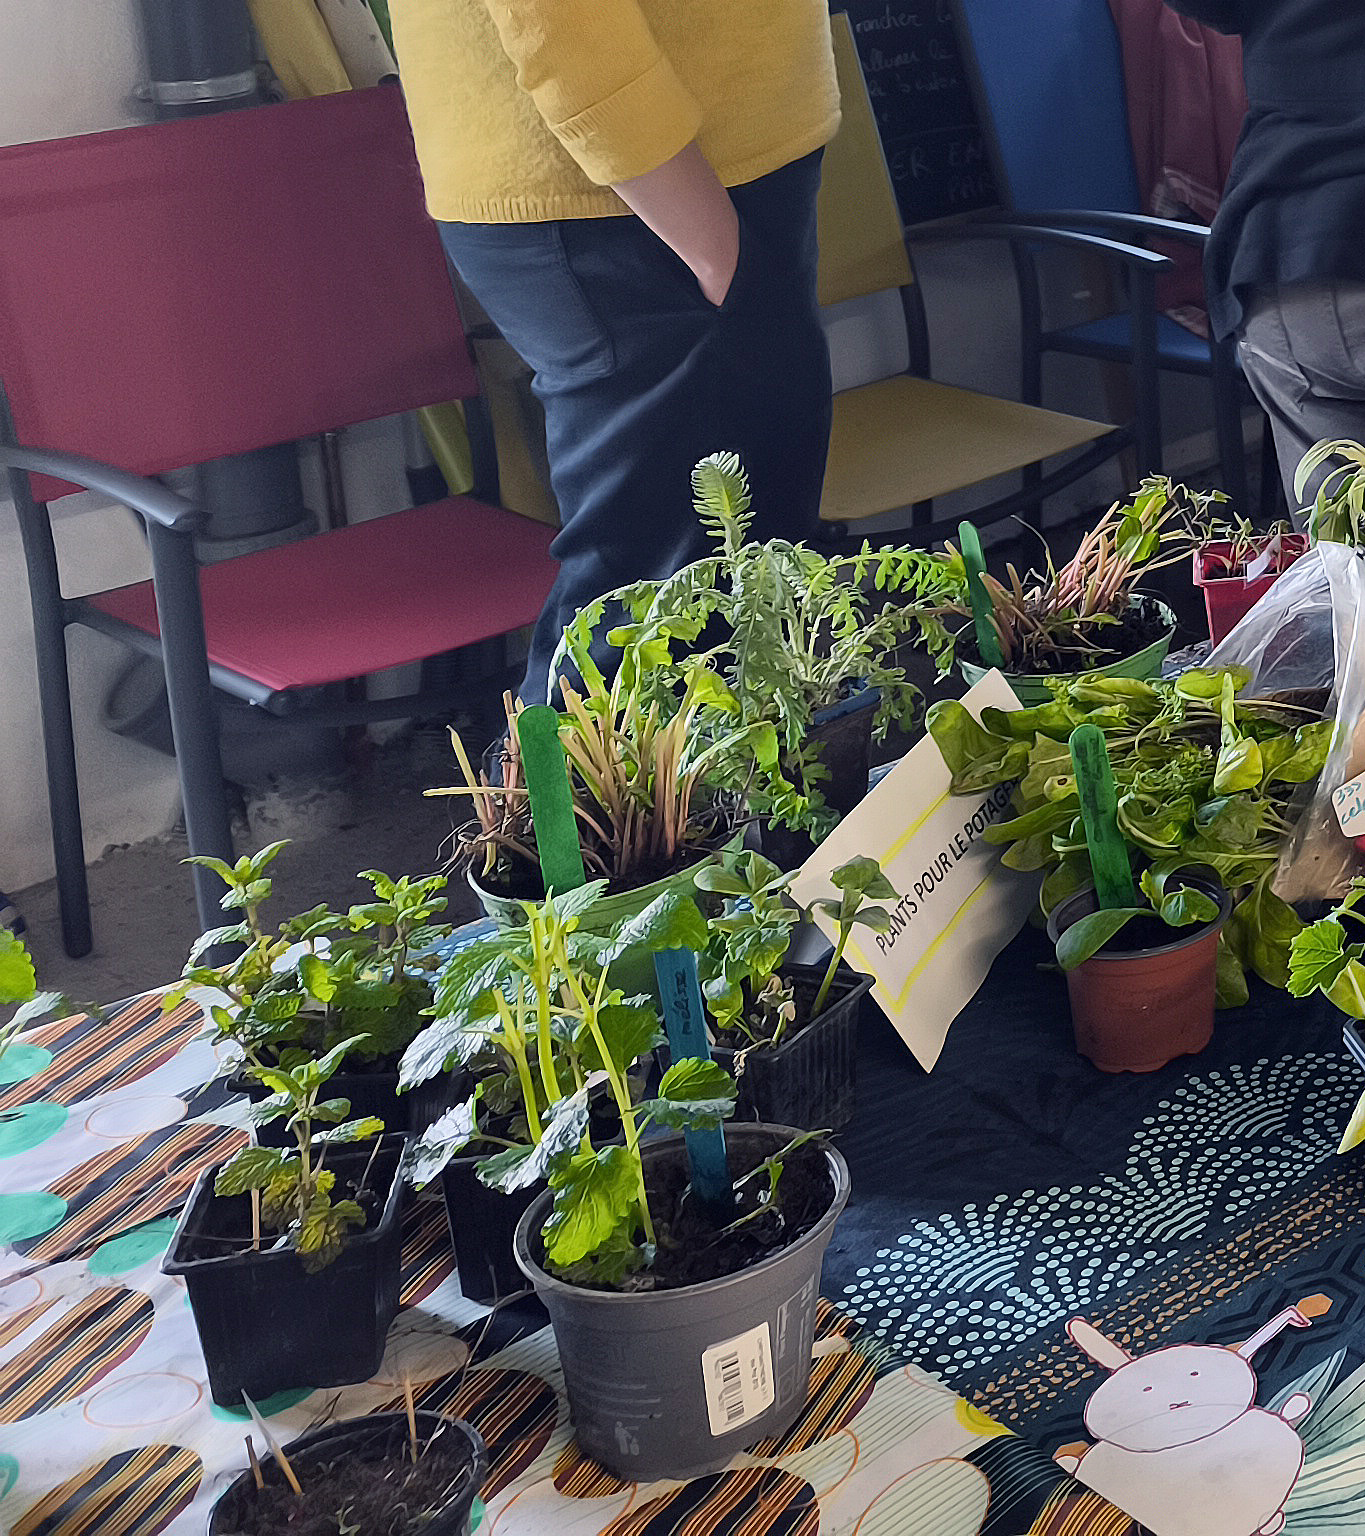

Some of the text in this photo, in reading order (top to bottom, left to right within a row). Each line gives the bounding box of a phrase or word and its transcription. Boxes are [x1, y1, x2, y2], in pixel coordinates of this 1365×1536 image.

[875, 778, 1022, 956] PLANTS POUR LE POTAGE
